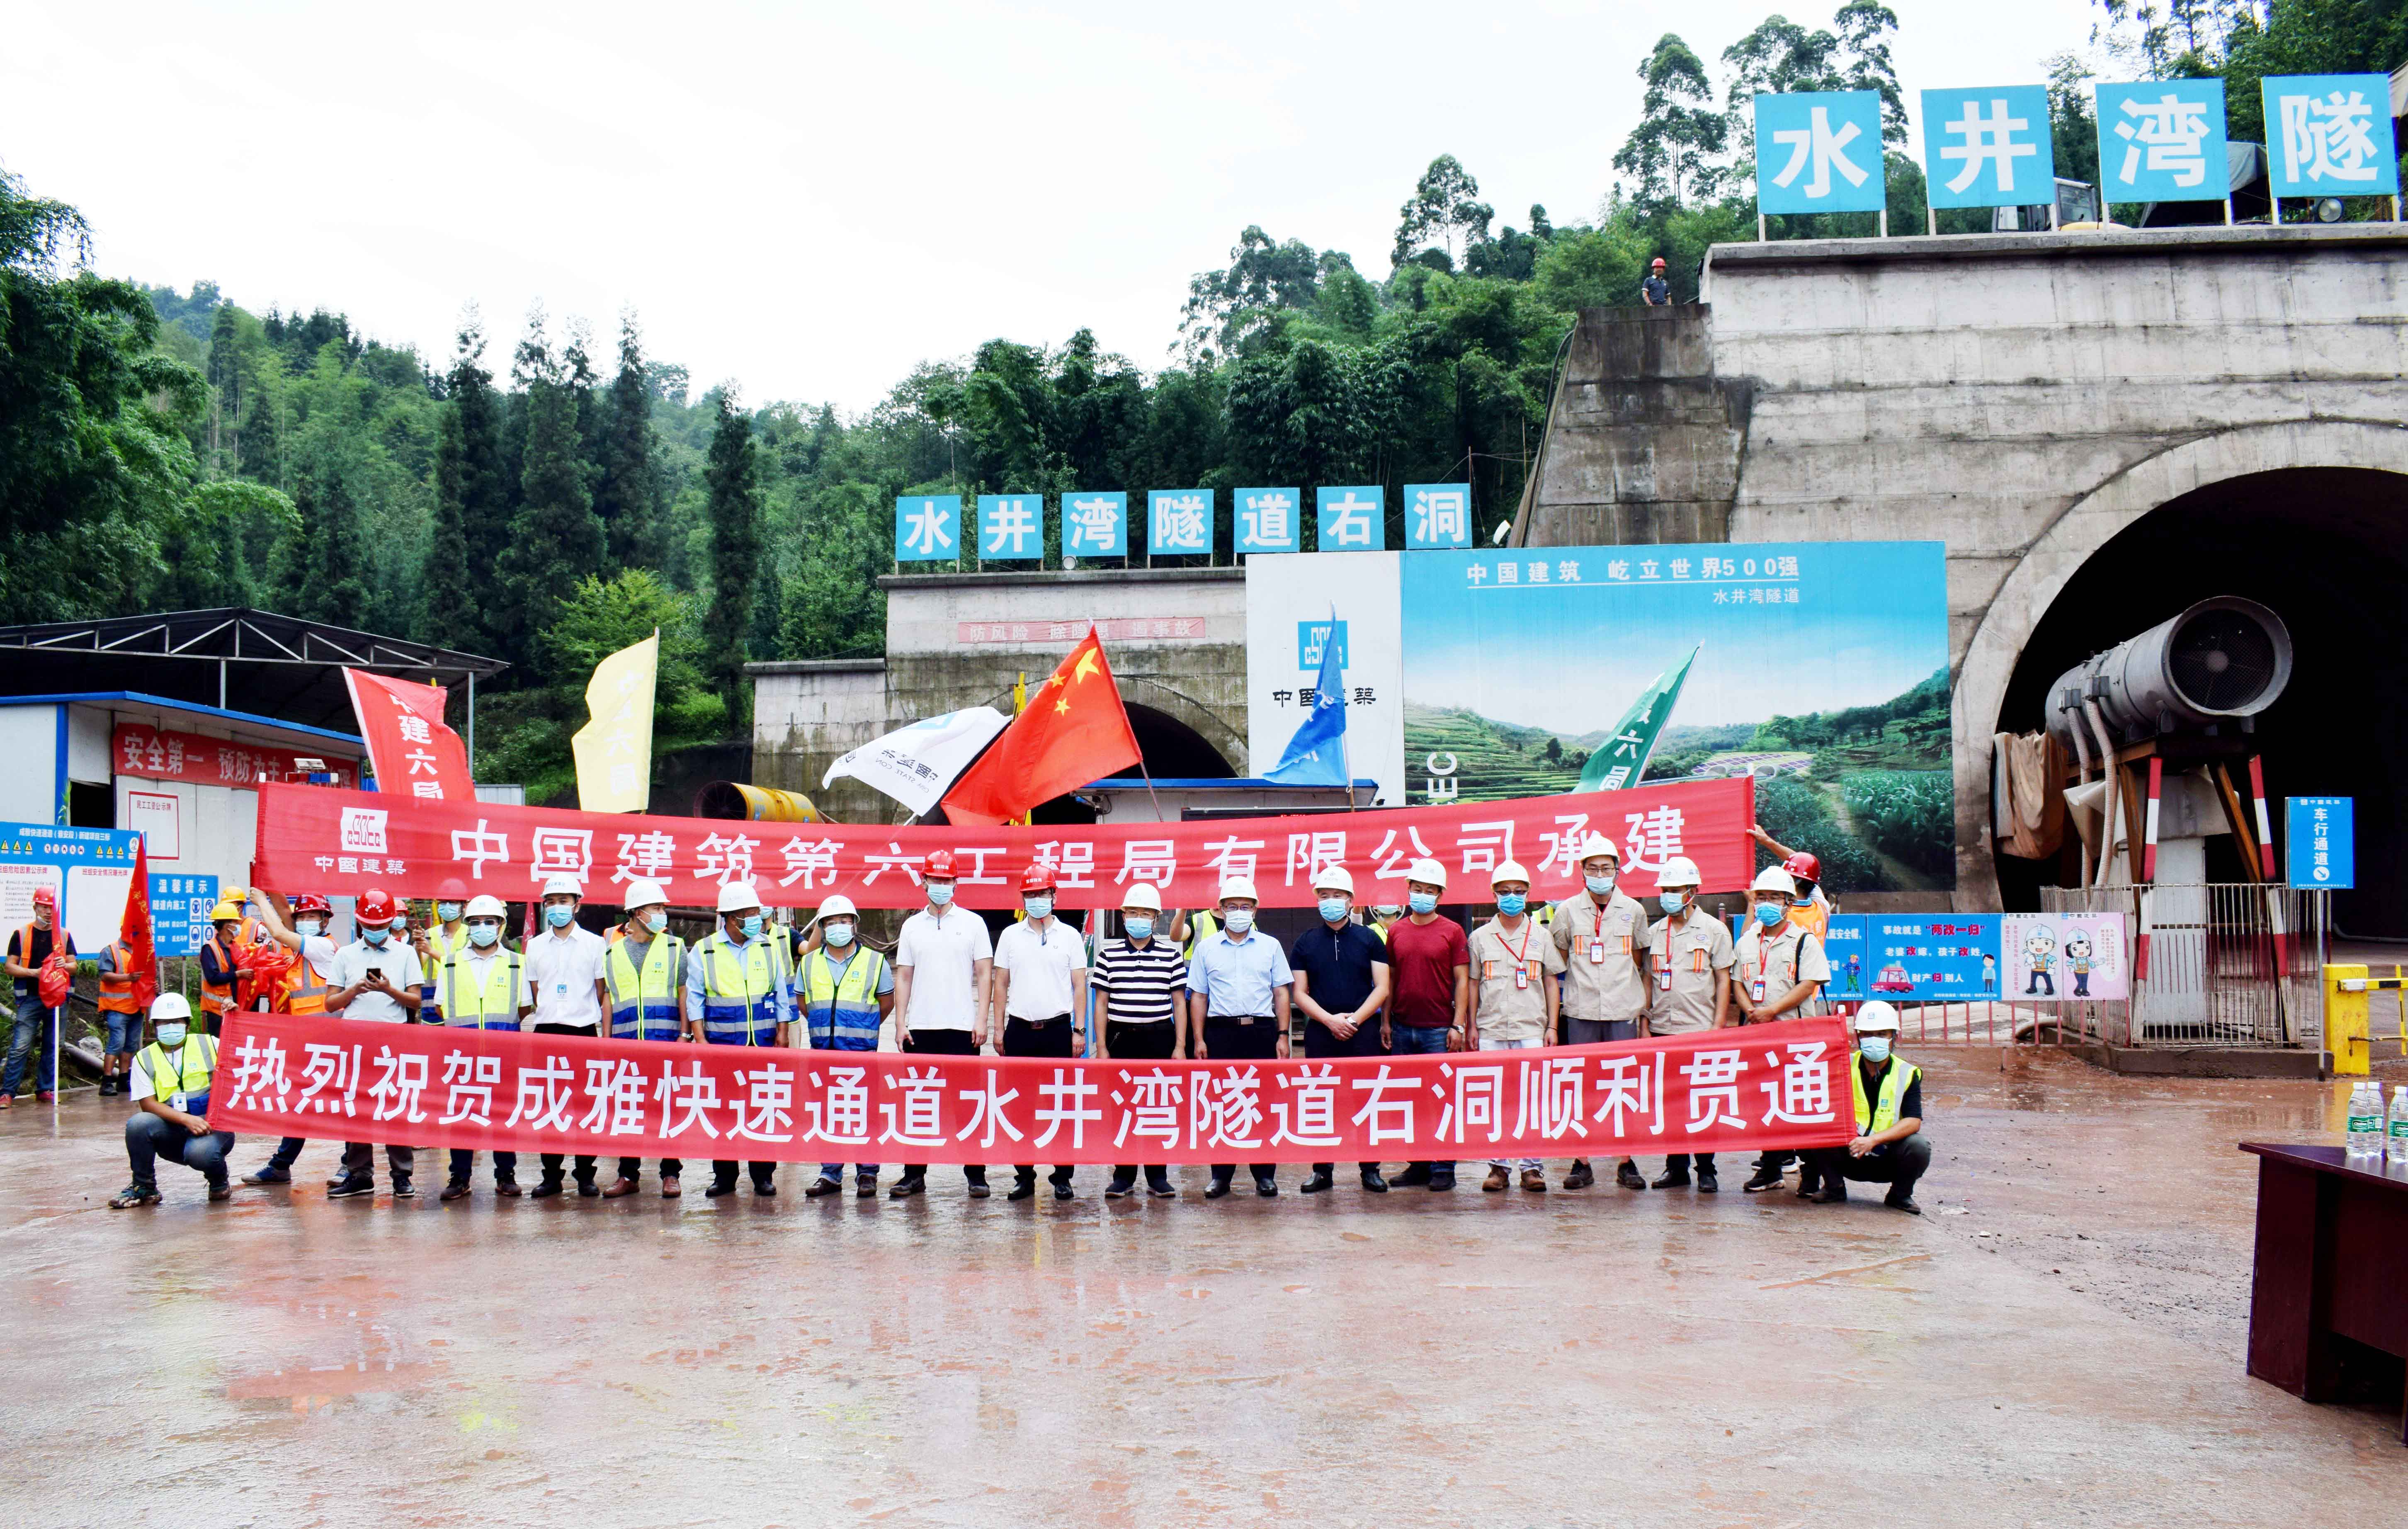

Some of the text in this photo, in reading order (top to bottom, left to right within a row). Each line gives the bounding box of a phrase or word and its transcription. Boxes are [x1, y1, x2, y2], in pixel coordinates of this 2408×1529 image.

[1771, 90, 2379, 198] 水井湾隧
[904, 490, 1464, 554] 水井湾隧道右洞
[1467, 556, 1799, 585] 中国建筑 屹立世界500强
[1713, 588, 1799, 605] 水井湾隧道
[970, 625, 1029, 641] 防风险
[1050, 623, 1109, 638] 除隐患
[1273, 687, 1376, 708] 中國築
[124, 733, 204, 775] 安全第一
[218, 748, 280, 783] 预防为主
[1427, 751, 1458, 805] EC
[451, 805, 1685, 889] 中国建筑第六工程局有限公司承建
[2313, 808, 2329, 865] 车行通道
[314, 855, 407, 875] 中國建築
[159, 879, 207, 893] 温馨提示
[1826, 928, 1862, 939] 戴安全帽，
[1912, 973, 1964, 983] 财产归别人
[226, 1035, 1835, 1150] 热烈祝贺成雅快速通道水井湾隧道右洞顺利贯通
